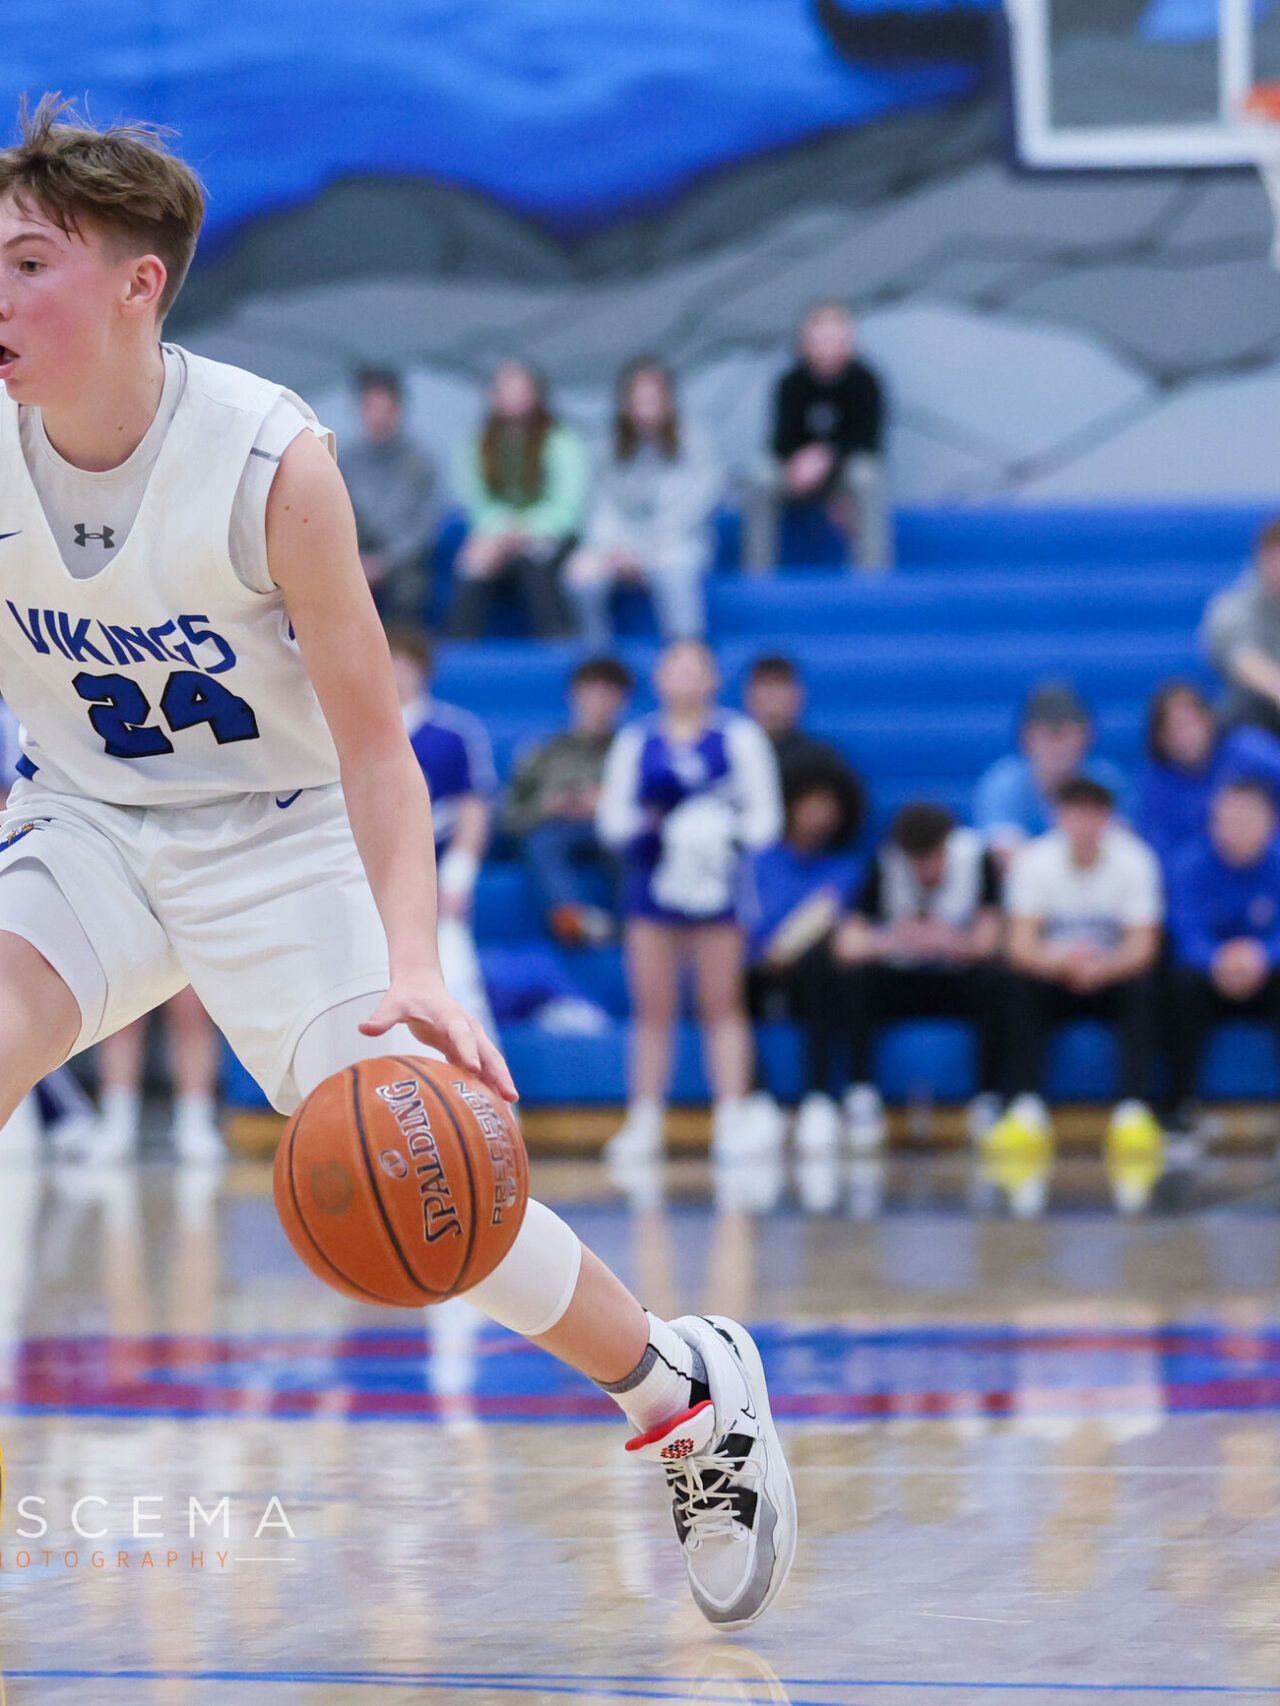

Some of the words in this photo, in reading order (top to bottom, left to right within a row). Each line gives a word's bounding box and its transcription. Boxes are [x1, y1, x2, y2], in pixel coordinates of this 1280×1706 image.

[5, 600, 237, 674] VIKINGS
[71, 670, 261, 759] 24
[376, 1079, 463, 1243] SPALDING
[451, 1080, 506, 1225] PRECISION
